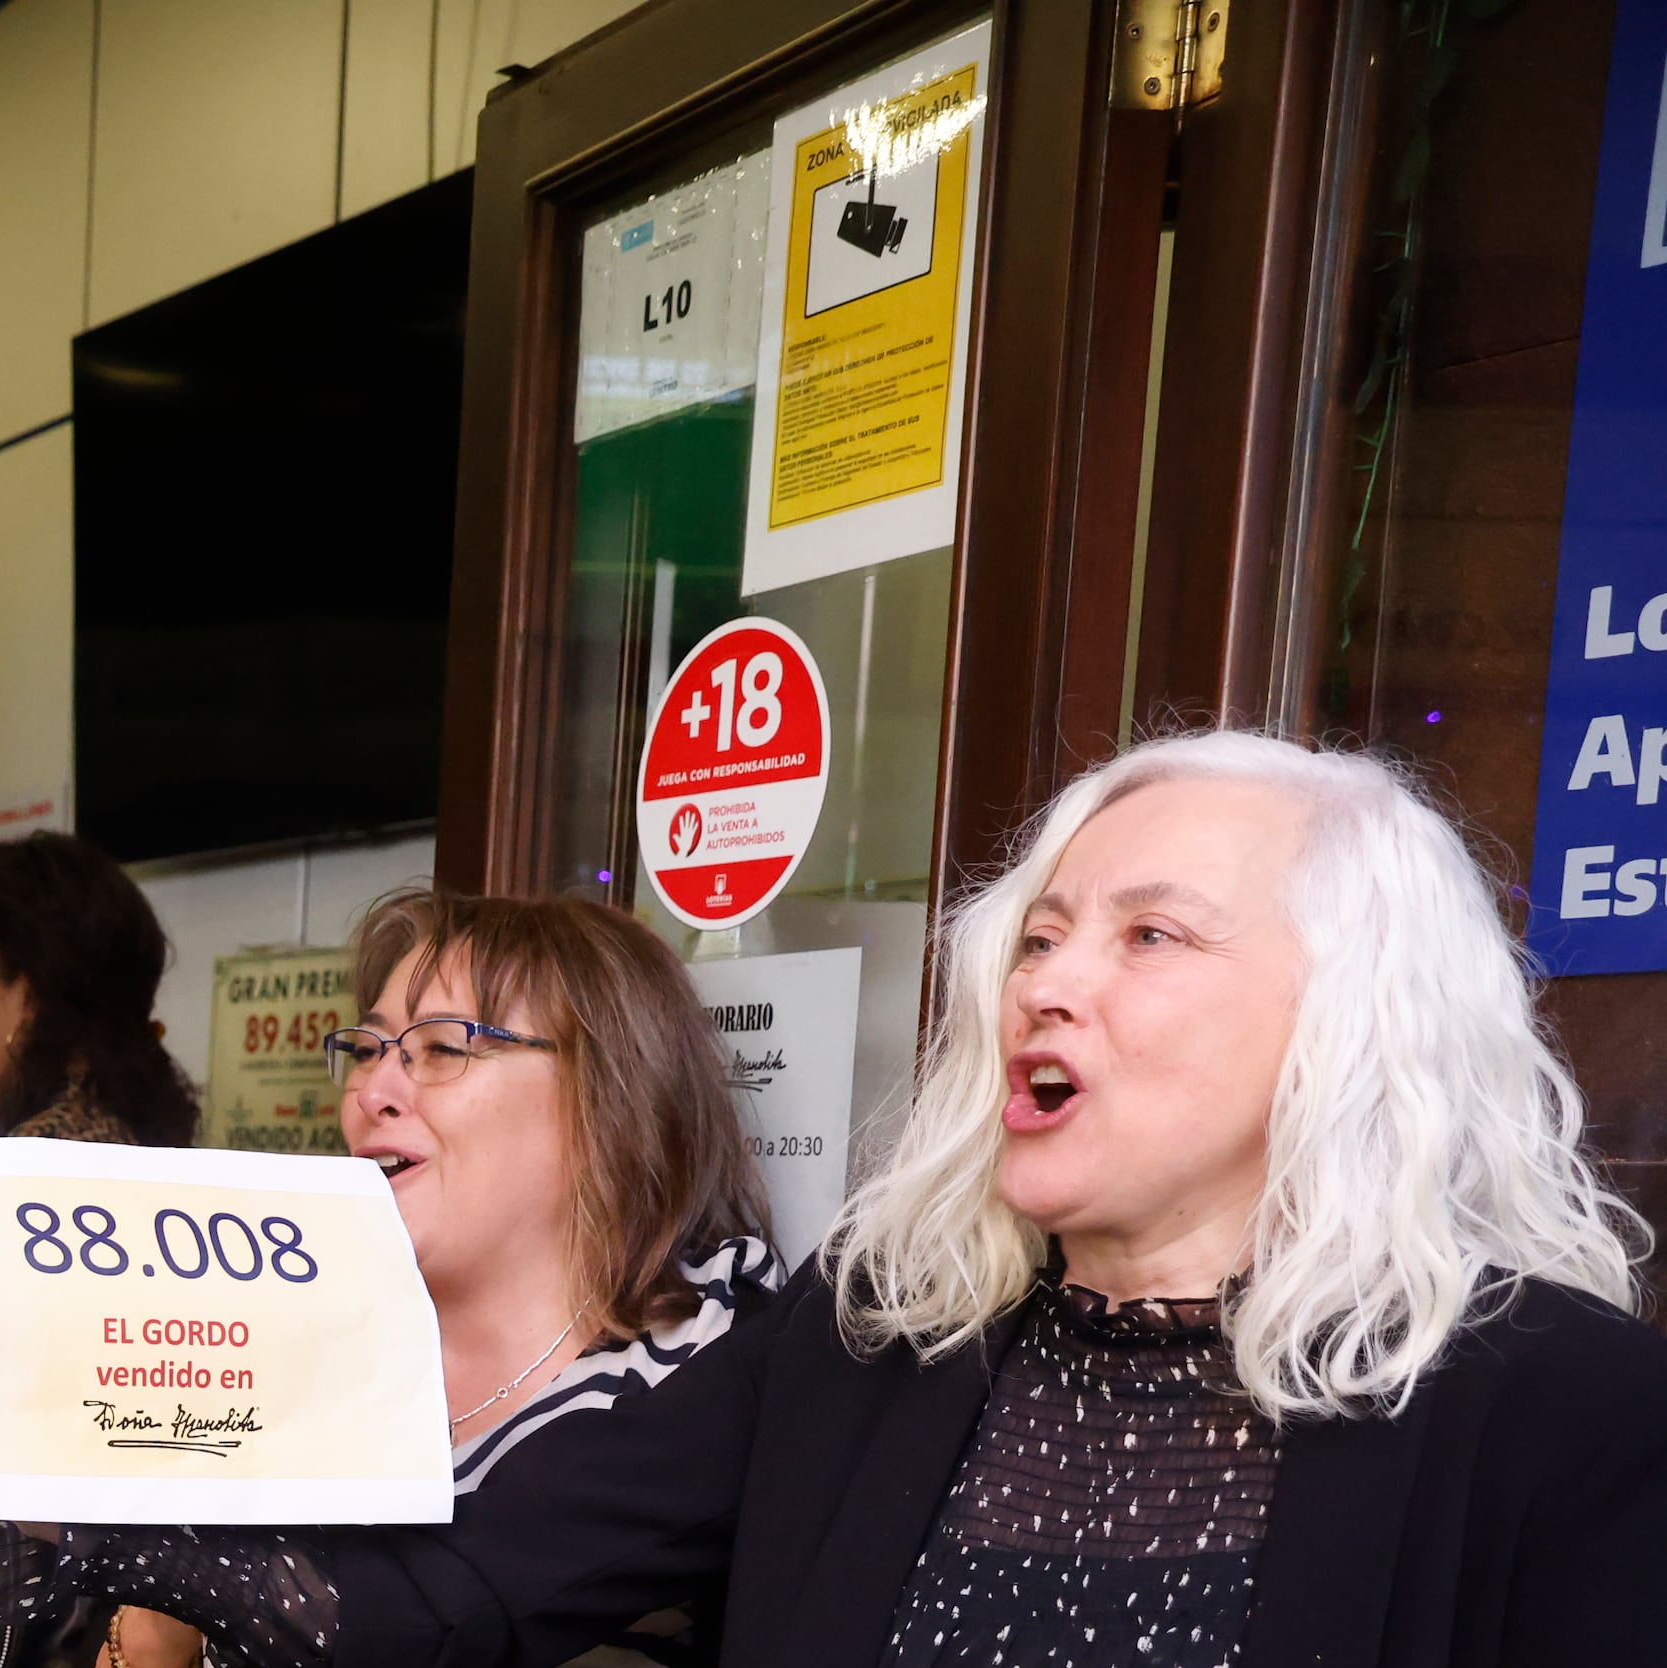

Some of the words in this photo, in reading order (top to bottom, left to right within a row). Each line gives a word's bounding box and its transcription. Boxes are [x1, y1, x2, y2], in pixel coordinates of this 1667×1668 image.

[807, 142, 845, 171] ZONA
[680, 650, 784, 752] +18
[657, 769, 688, 787] JUEGA
[689, 766, 711, 783] CON
[712, 752, 806, 779] RESPONSABILIDAD
[708, 801, 756, 817] PROHIBIDA
[705, 830, 786, 850] AUTOPROHIBIDOS
[707, 820, 719, 834] LA
[720, 819, 750, 833] VENTA
[751, 819, 759, 830] A
[228, 971, 291, 1003] GRAN
[766, 1141, 775, 1156] a
[779, 1136, 823, 1157] 20:30
[15, 1201, 320, 1285] 88.008
[103, 1317, 134, 1345] EL
[142, 1318, 250, 1348] GORDO
[96, 1360, 212, 1389] vendido
[219, 1365, 254, 1390] en
